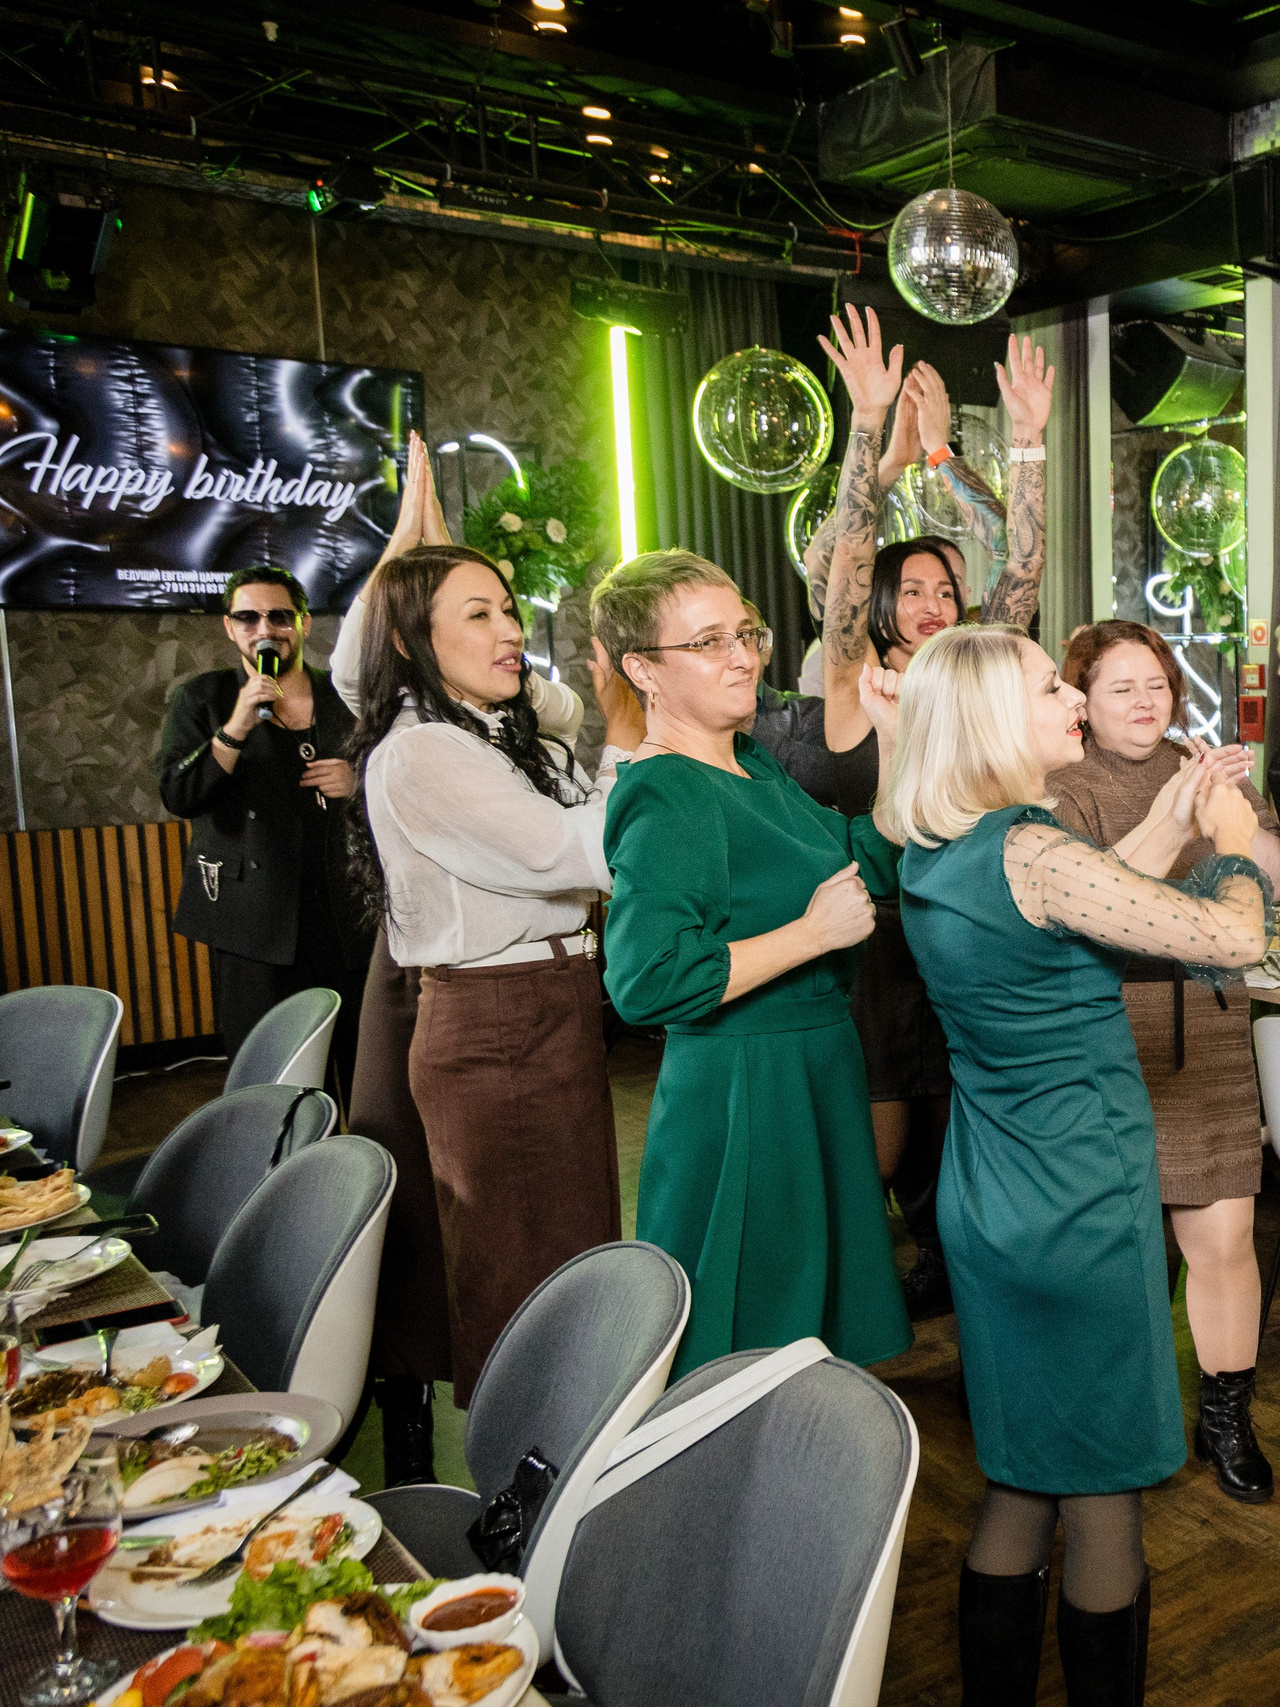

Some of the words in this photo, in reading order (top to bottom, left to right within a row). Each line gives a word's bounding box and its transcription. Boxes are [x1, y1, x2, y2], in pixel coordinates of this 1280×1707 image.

[0, 432, 176, 512] Happy
[183, 453, 356, 522] birthday
[116, 568, 160, 581] ВЕДУЩИЙ
[161, 570, 198, 582] ЕВГЕНИЙ
